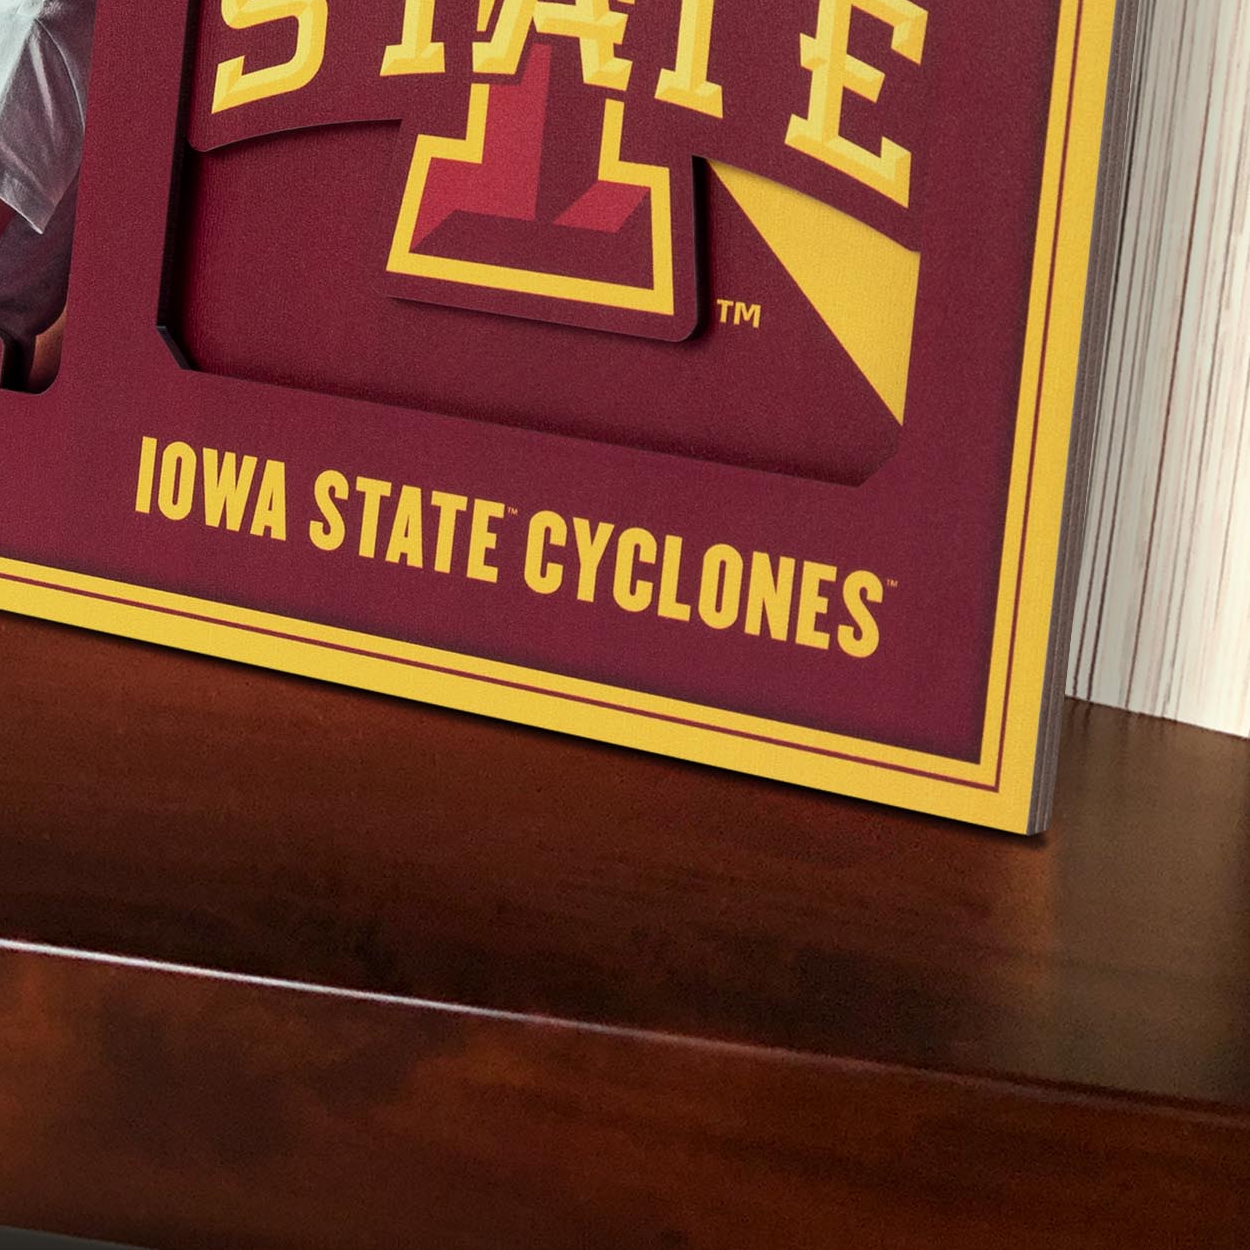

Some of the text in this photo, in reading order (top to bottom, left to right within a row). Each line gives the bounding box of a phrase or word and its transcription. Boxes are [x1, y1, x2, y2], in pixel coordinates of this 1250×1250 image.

[716, 299, 762, 328] TM
[135, 435, 287, 541] IOWA
[309, 469, 507, 583] STATE
[523, 510, 885, 659] CYCLONES
